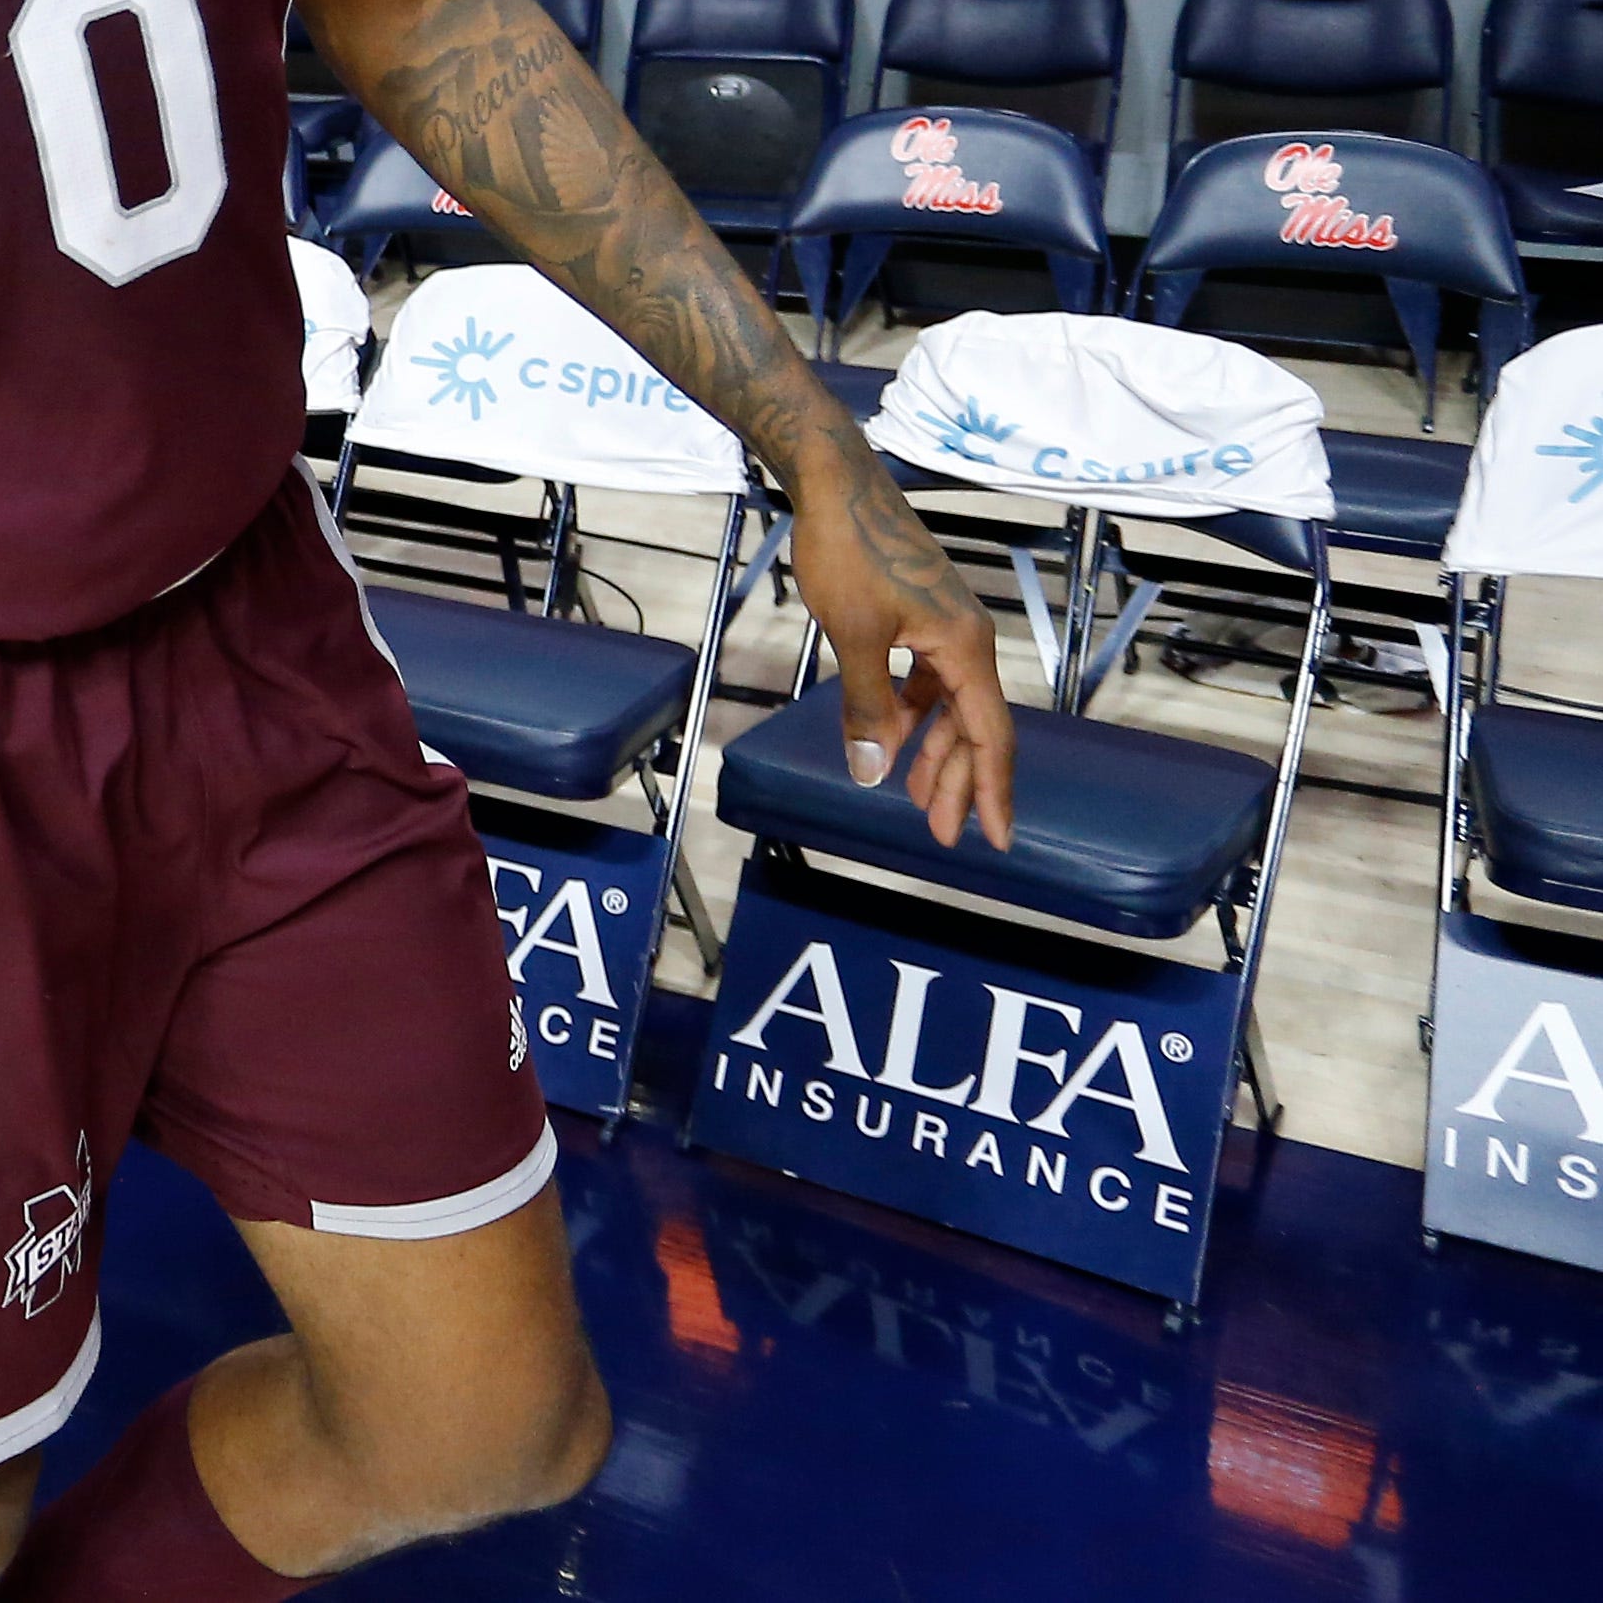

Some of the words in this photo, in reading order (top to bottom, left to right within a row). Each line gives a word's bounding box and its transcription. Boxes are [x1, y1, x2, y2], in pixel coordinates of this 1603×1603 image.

[892, 117, 958, 162] Ole
[903, 163, 1003, 214] Miss
[1265, 143, 1342, 192] Ole
[1281, 193, 1398, 250] Miss
[558, 361, 690, 412] spire
[713, 1052, 1193, 1234] INSURANCE
